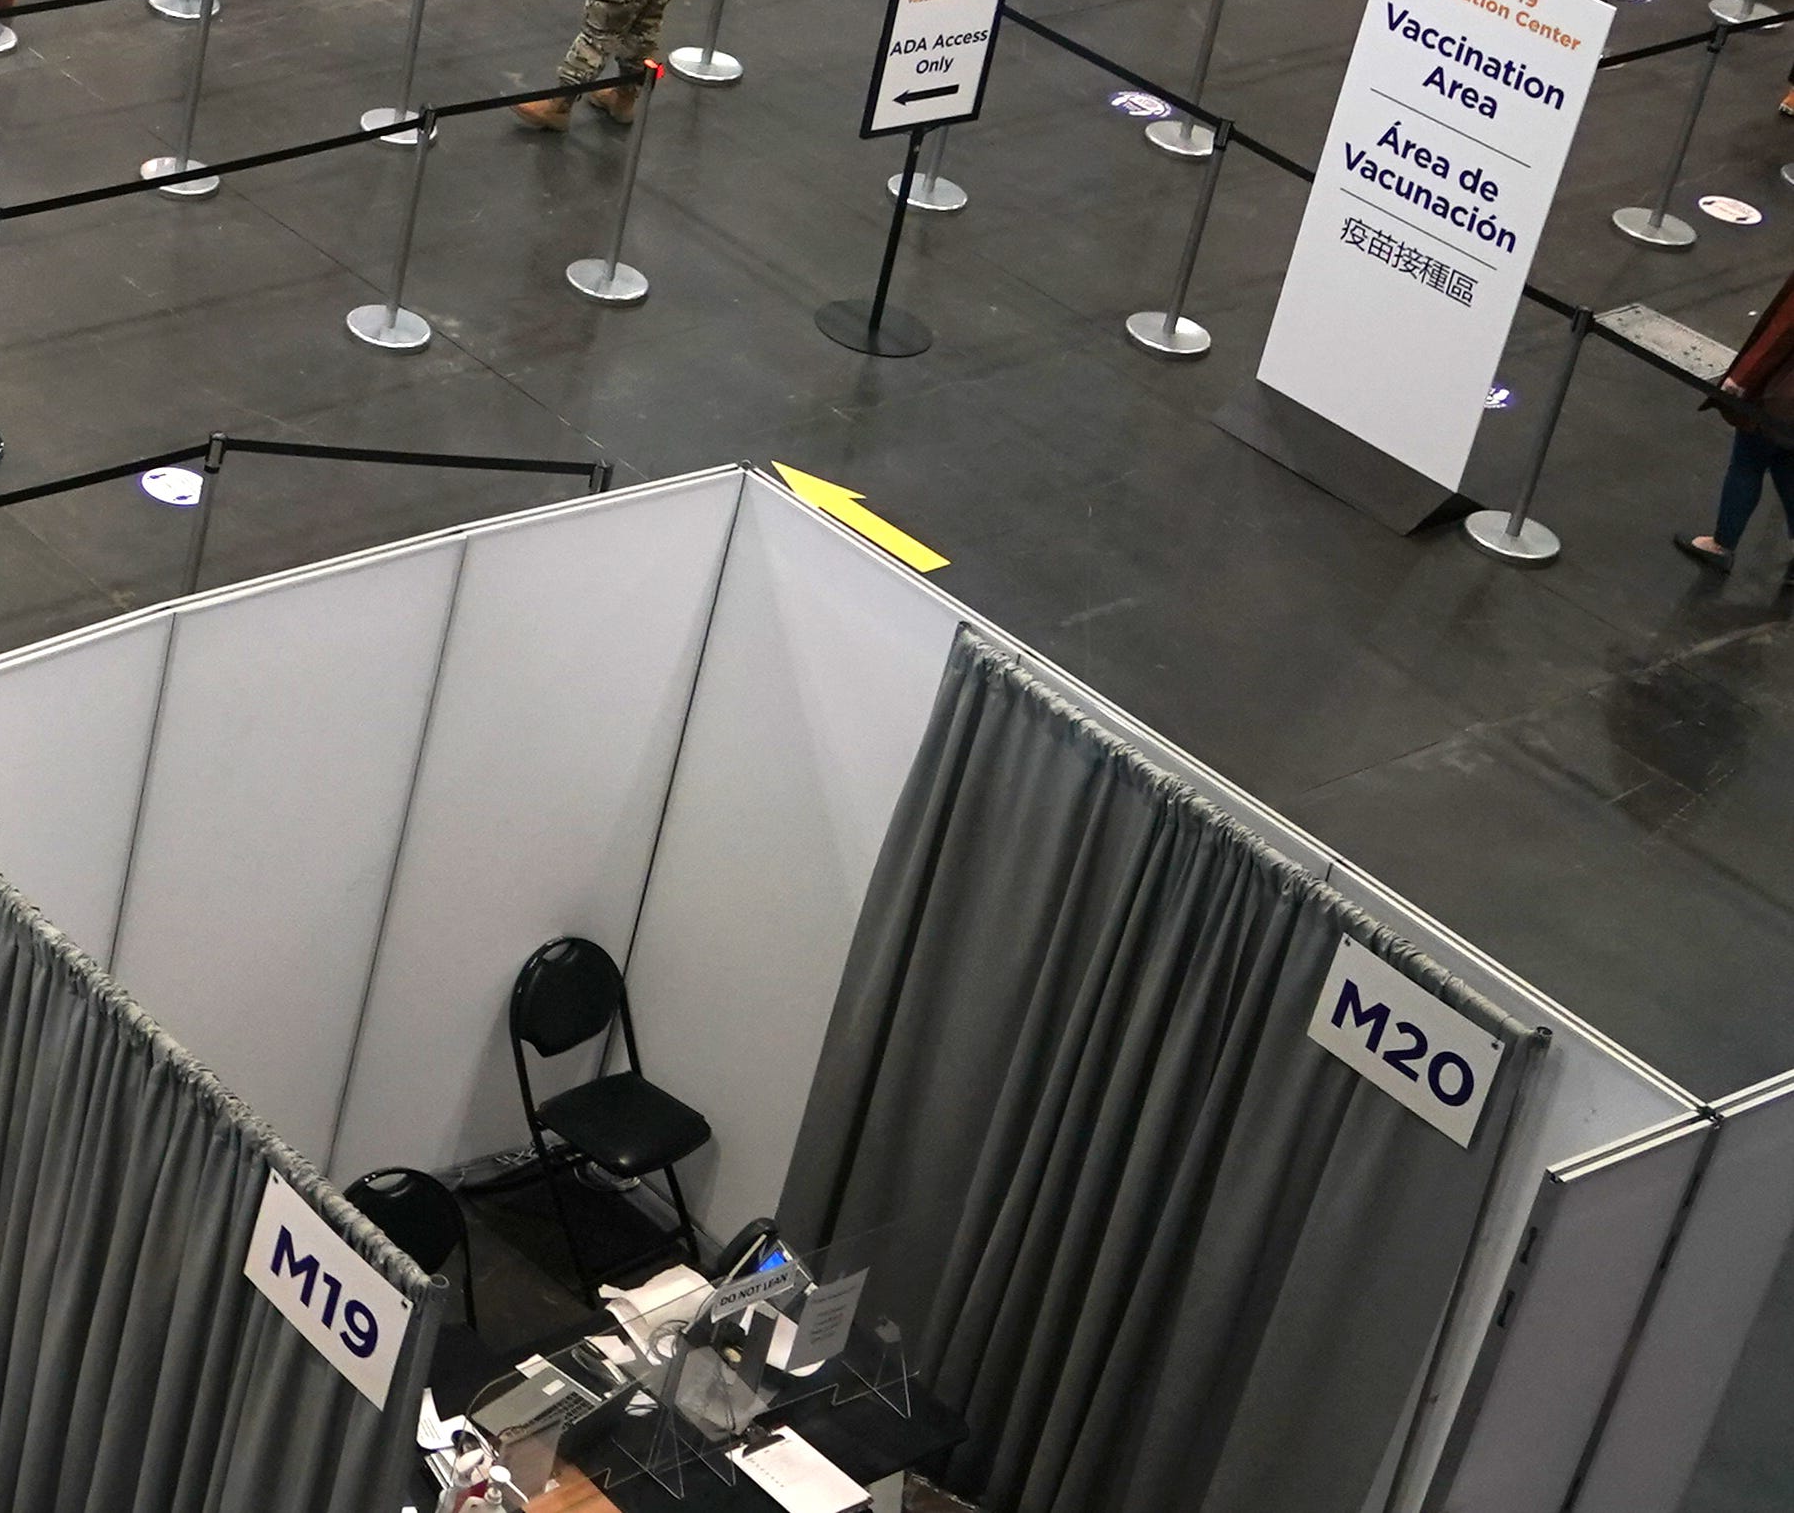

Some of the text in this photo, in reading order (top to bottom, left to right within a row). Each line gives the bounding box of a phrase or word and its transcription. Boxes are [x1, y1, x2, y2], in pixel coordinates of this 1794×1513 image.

[890, 29, 989, 57] ADA Access
[916, 55, 954, 75] Only
[1386, 1, 1566, 111] Vaccination
[1515, 10, 1581, 52] Center
[1422, 66, 1499, 120] Area
[1345, 141, 1517, 254] Vacunación
[1376, 120, 1499, 203] Área de
[1340, 216, 1479, 309] 疫苗接種區
[1330, 978, 1475, 1107] M20
[270, 1225, 379, 1359] M19
[720, 1272, 788, 1307] DO NOT LEAN
